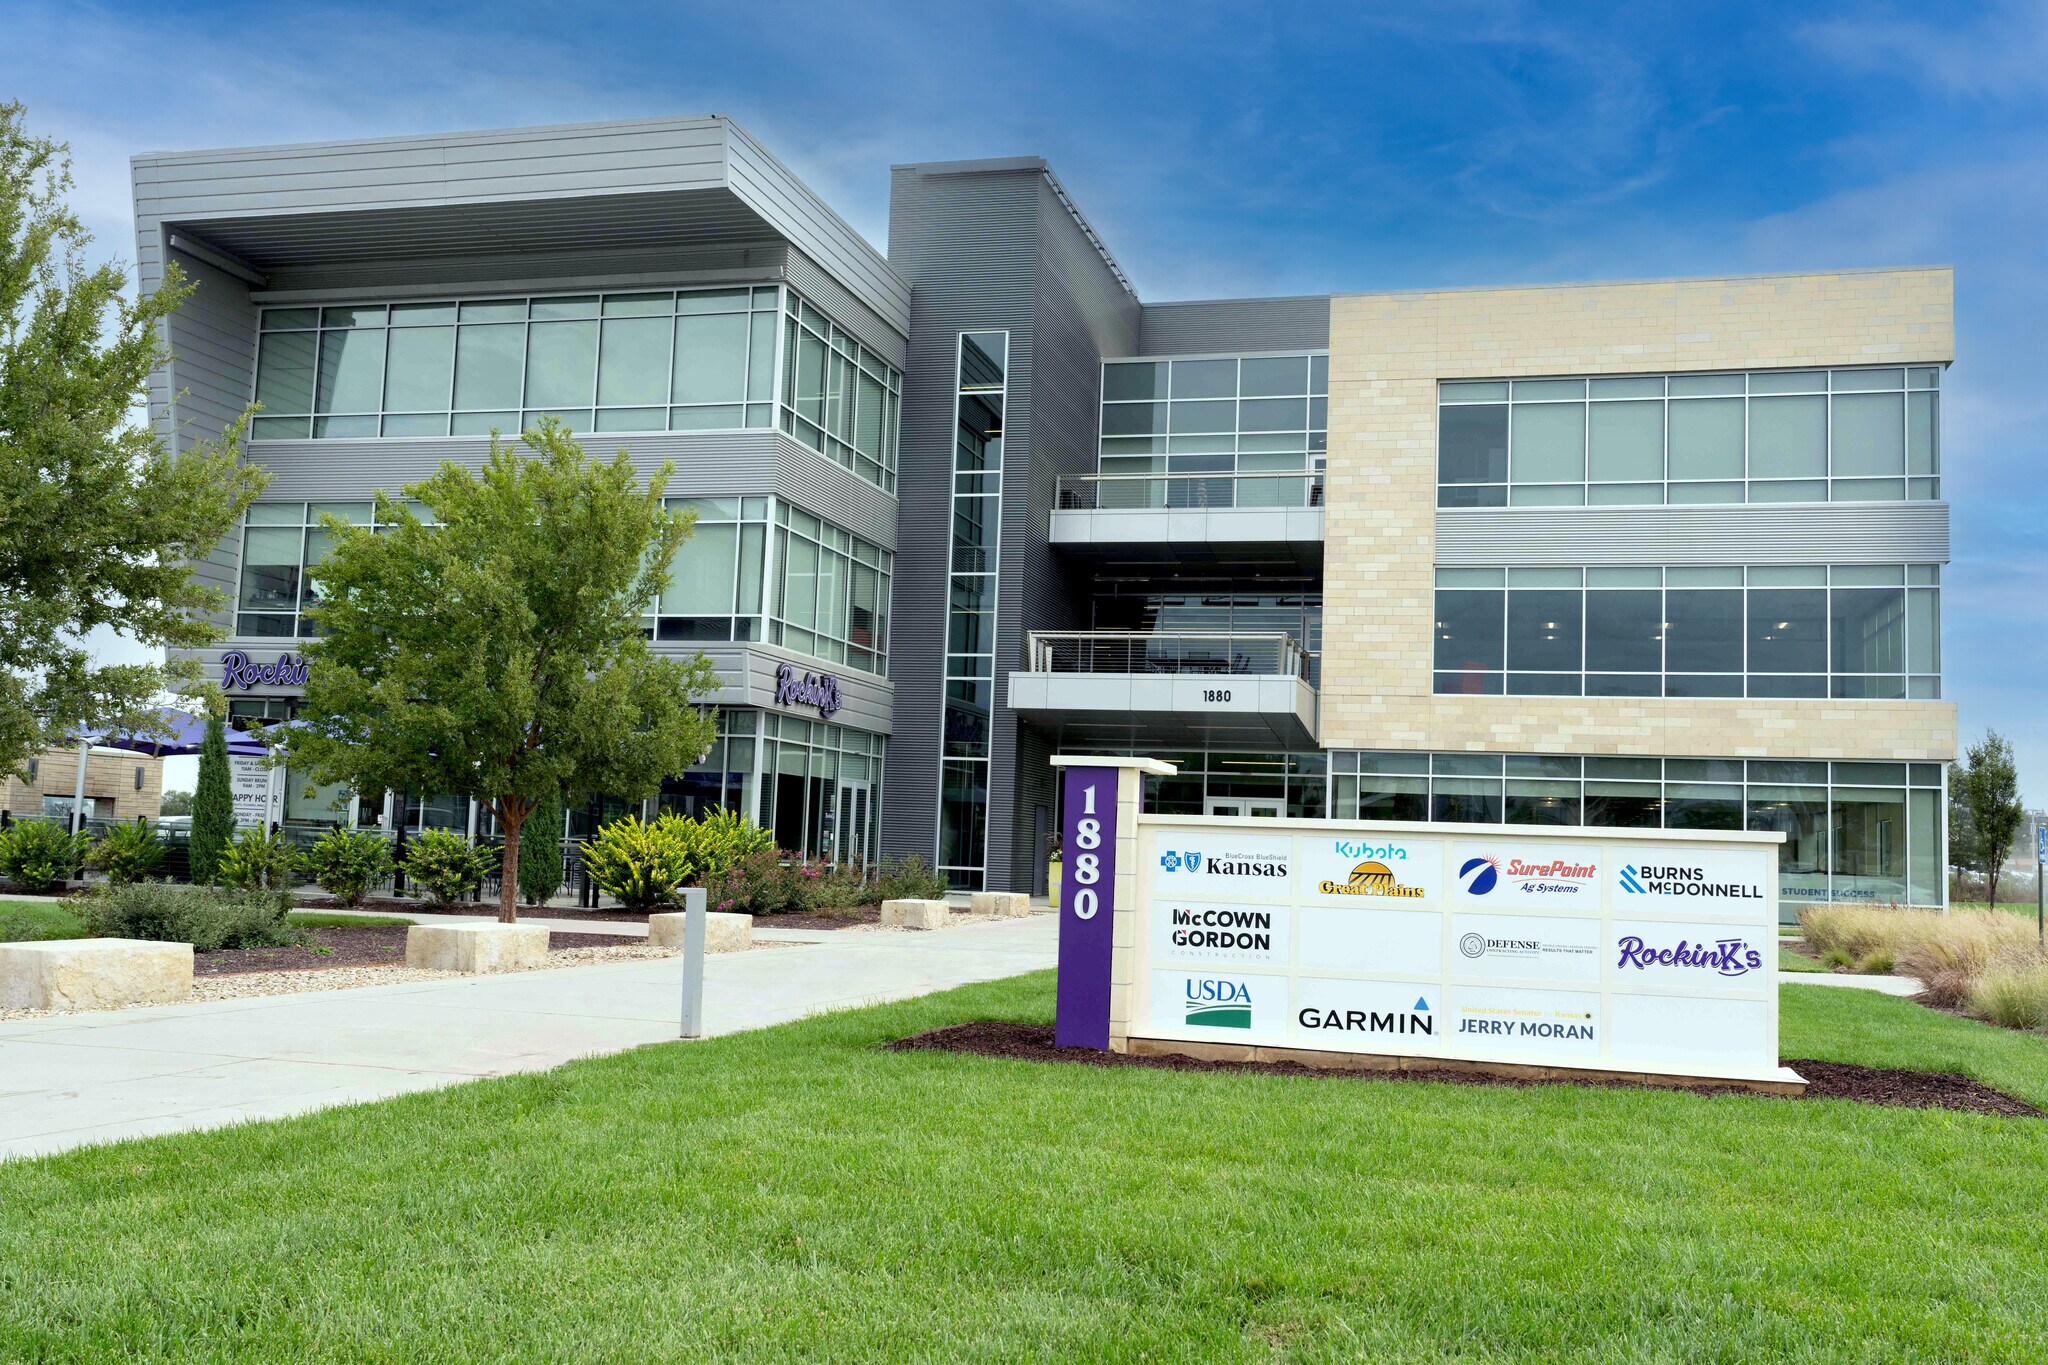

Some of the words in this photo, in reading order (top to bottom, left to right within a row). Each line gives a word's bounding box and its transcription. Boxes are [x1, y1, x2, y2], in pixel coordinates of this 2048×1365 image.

[1203, 690, 1231, 702] 1880
[1074, 784, 1101, 920] 1880
[1225, 852, 1255, 860] BlueCross
[1256, 853, 1288, 861] BlueShield
[1335, 842, 1407, 860] Kubota
[1206, 858, 1288, 877] Kansas
[1507, 859, 1597, 878] SurePoint
[1641, 866, 1704, 880] BURNS
[1318, 880, 1369, 895] Great
[1371, 883, 1425, 898] Plains
[1520, 882, 1535, 893] Ag
[1536, 883, 1579, 894] Systems
[1782, 887, 1827, 896] STUDENT
[1831, 889, 1876, 898] SUCCESS
[1173, 909, 1270, 929] McCOWN
[1172, 930, 1270, 950] GORDON
[1487, 939, 1540, 950] DEFENSE
[1171, 950, 1270, 960] CONSTRUCTION
[1618, 936, 1762, 976] RockinK's
[1186, 979, 1252, 1003] USDA
[1461, 1006, 1487, 1014] United
[1488, 1007, 1511, 1015] States
[1513, 1009, 1542, 1017] Senator
[1555, 1010, 1582, 1019] Kansas
[1298, 1008, 1433, 1036] GARMIN
[1459, 1019, 1516, 1035] JERRY
[1520, 1022, 1594, 1040] MORAN
